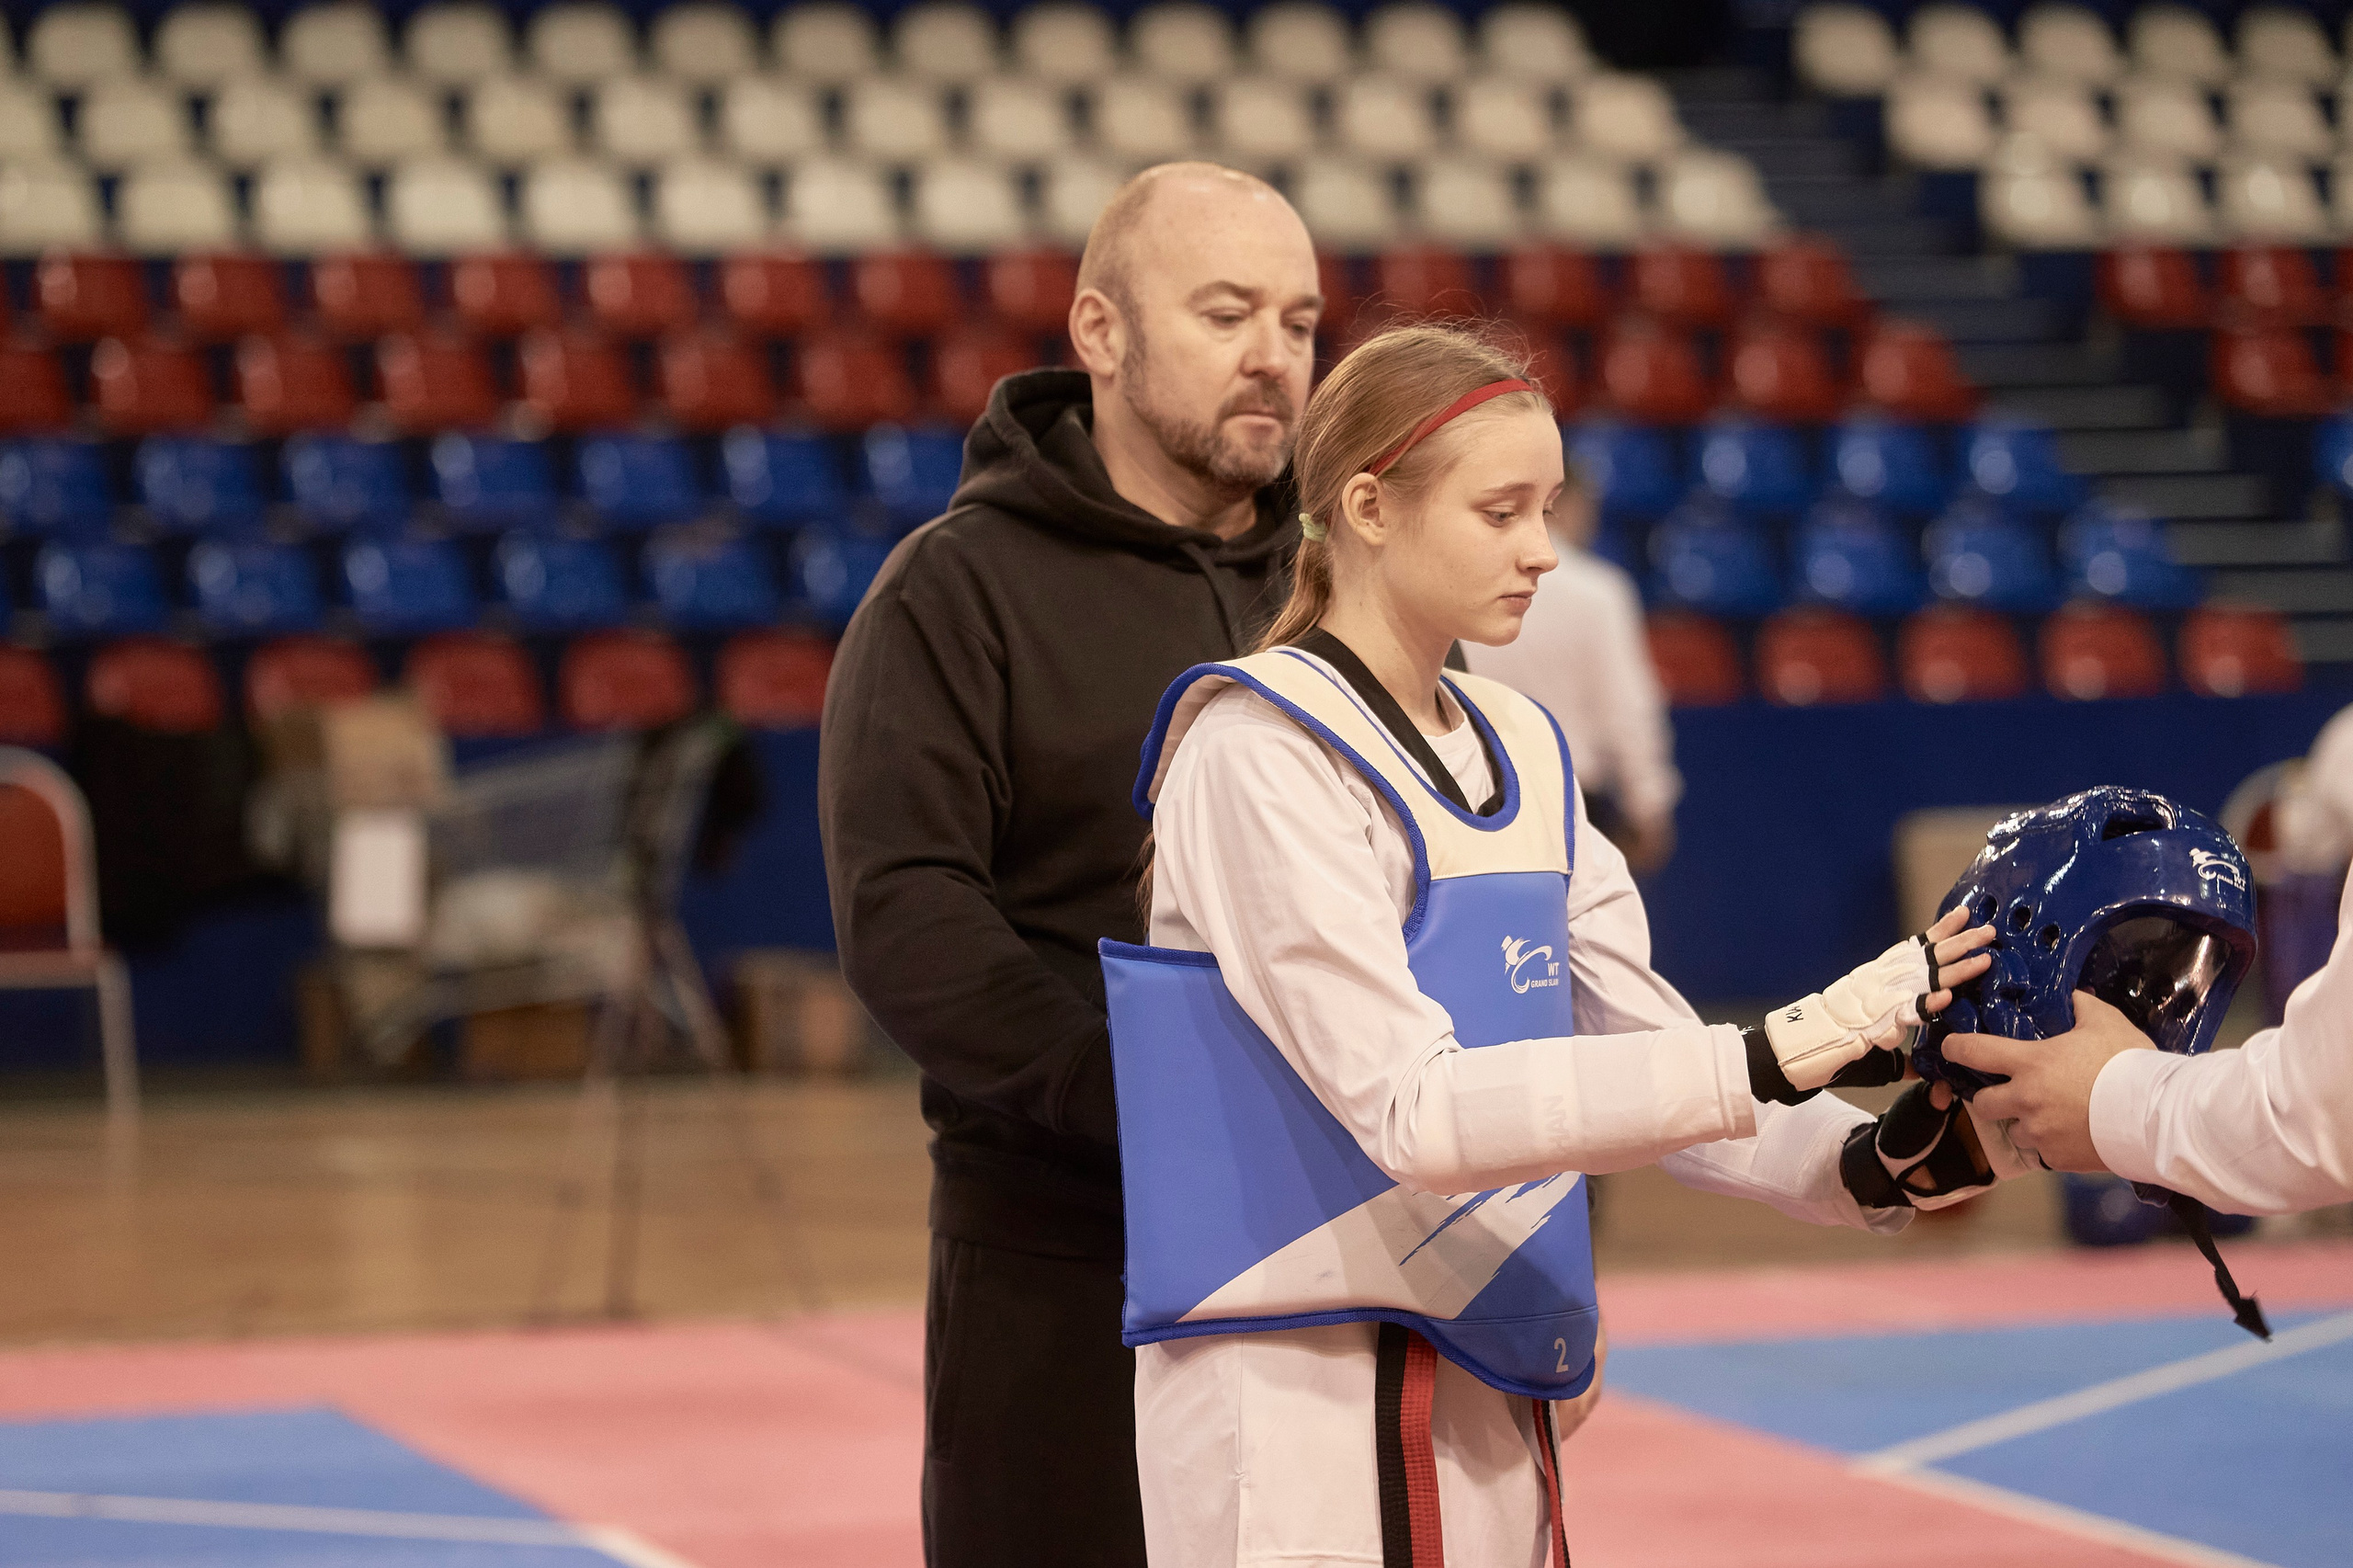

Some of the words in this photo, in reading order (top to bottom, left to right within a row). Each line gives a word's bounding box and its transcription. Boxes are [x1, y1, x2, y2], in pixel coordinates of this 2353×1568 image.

[1547, 962, 1560, 976] WT
[1530, 979, 1548, 988] GRAND
[1554, 1337, 1569, 1373] 2
